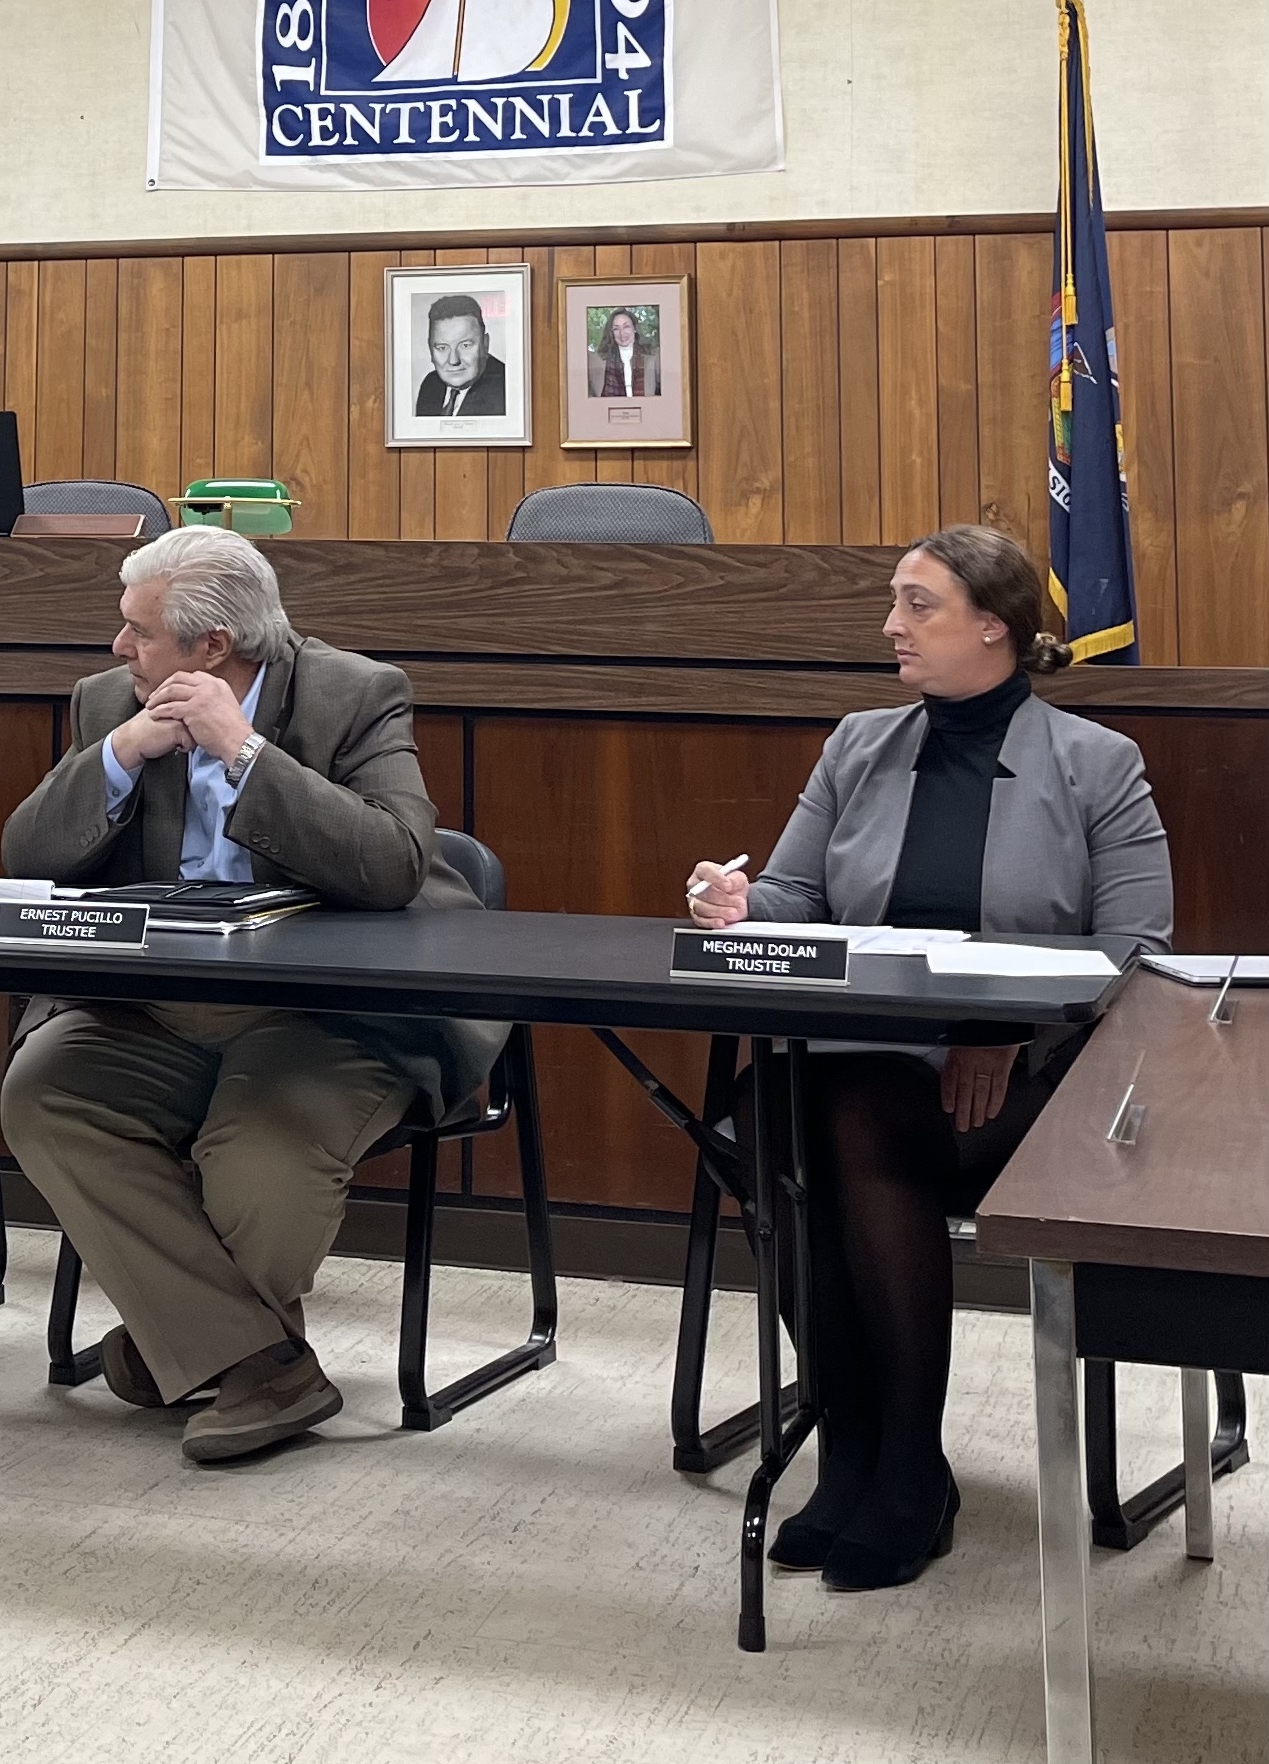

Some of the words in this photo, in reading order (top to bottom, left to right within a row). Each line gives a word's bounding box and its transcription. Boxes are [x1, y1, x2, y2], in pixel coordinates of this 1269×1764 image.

[271, 88, 660, 148] CENTENNIAL
[20, 908, 69, 921] ERNEST
[71, 911, 123, 924] PUCILLO
[41, 924, 97, 937] TRUSTEE
[702, 940, 763, 955] MEGHAN
[767, 944, 817, 959] DOLAN
[725, 958, 791, 973] TRUSTEE
